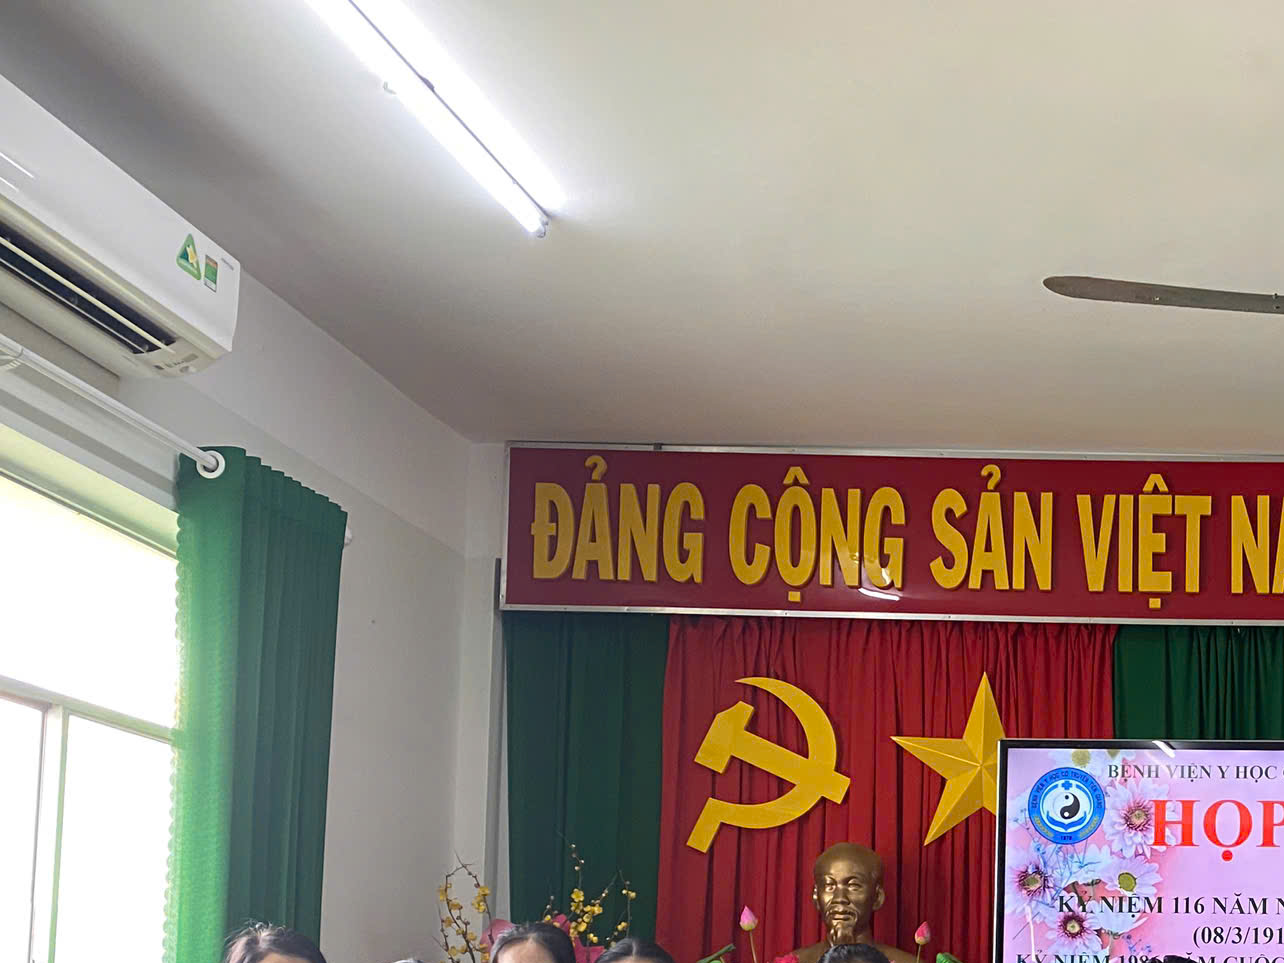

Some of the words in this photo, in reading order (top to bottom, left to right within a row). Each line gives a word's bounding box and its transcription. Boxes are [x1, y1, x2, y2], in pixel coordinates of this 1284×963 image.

[530, 456, 705, 584] ĐẢNG
[729, 466, 907, 602] CỘNG
[930, 464, 1054, 592] SẢN
[1076, 473, 1213, 609] VIỆT
[1107, 763, 1160, 782] BỆNH
[1165, 763, 1212, 782] VIỆN
[1217, 765, 1230, 779] Y
[1235, 765, 1277, 783] HỌC
[1100, 893, 1163, 918] NIỆM
[1172, 896, 1205, 915] 116
[1212, 893, 1268, 915] NĂM
